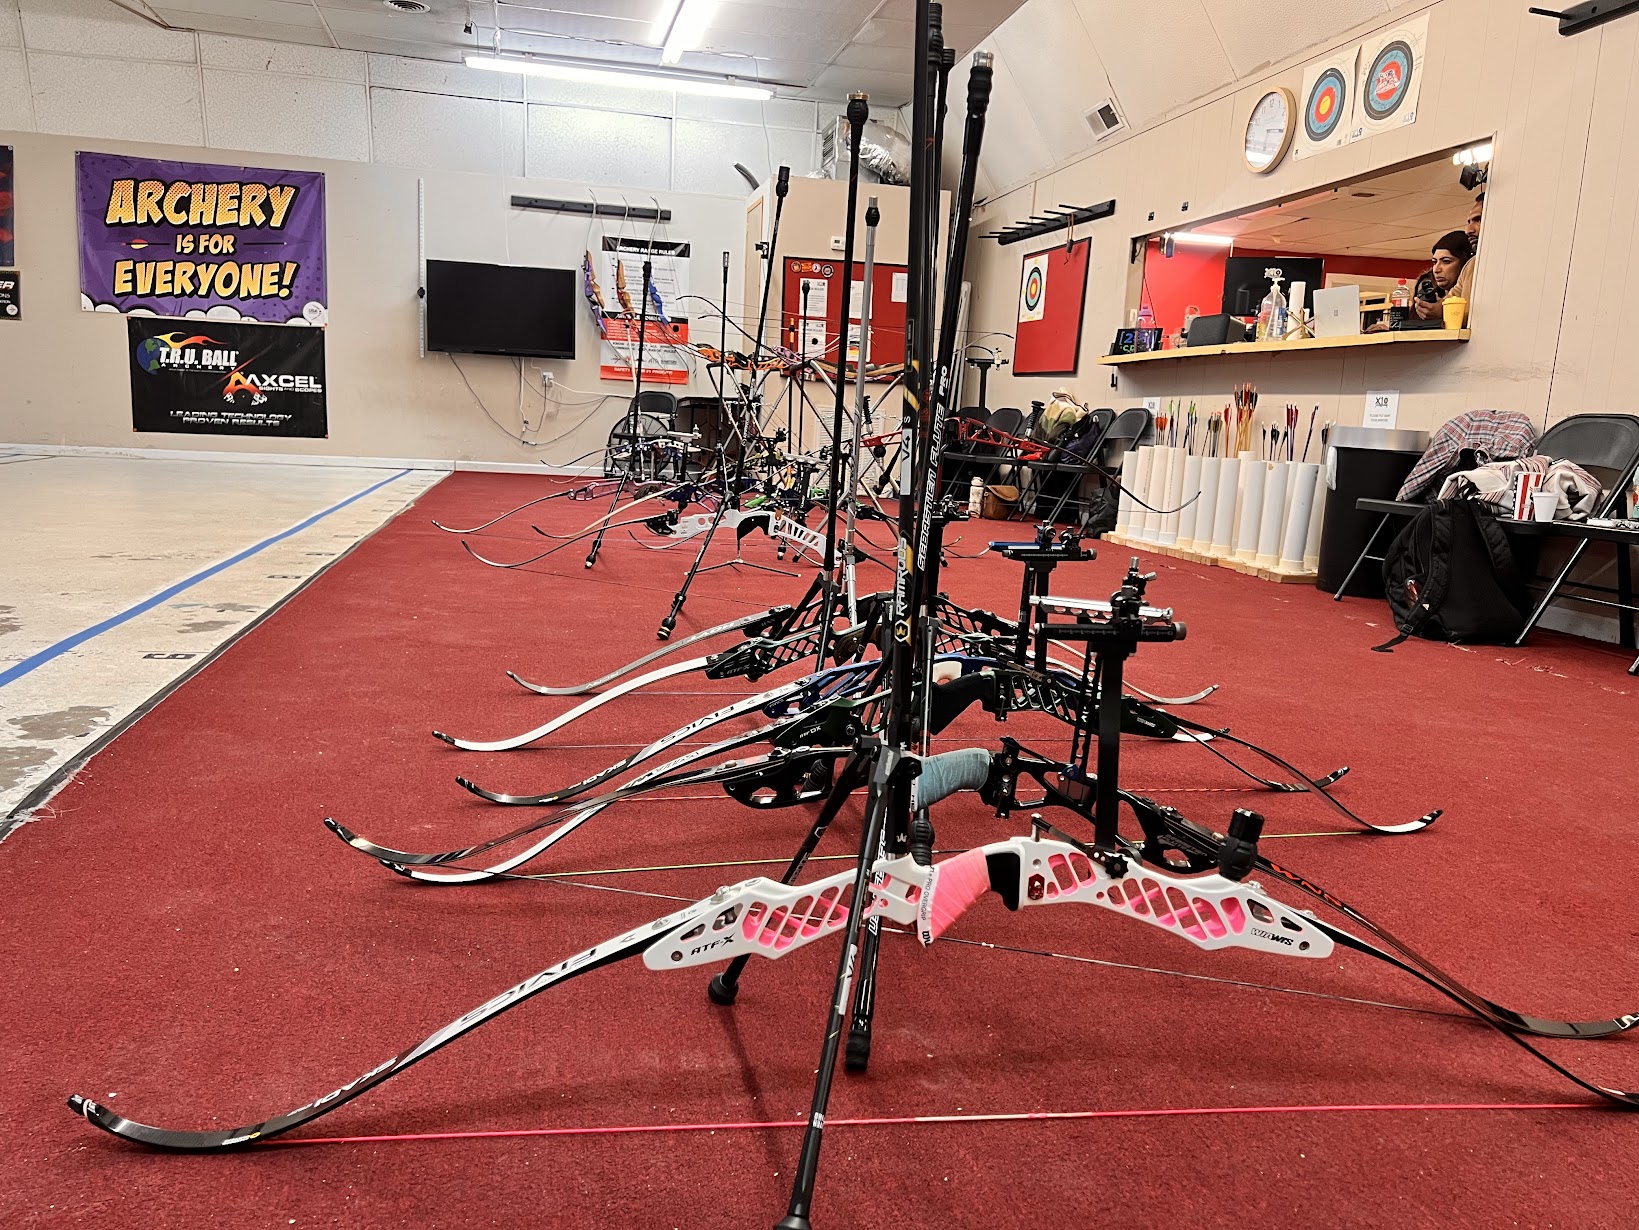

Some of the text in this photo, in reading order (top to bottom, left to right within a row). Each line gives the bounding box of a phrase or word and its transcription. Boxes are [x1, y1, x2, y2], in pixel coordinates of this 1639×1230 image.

[105, 178, 297, 228] ARCHERY
[175, 234, 235, 254] IS FOR
[114, 260, 298, 298] EVERYONE!
[159, 347, 238, 367] T.R.U. BALL
[170, 410, 293, 421] LEADING TECHNOLOGY
[182, 416, 281, 427] PROVEN RESULTS
[929, 402, 946, 467] FLUTE
[938, 365, 948, 397] PRO
[690, 932, 735, 957] ATF-X
